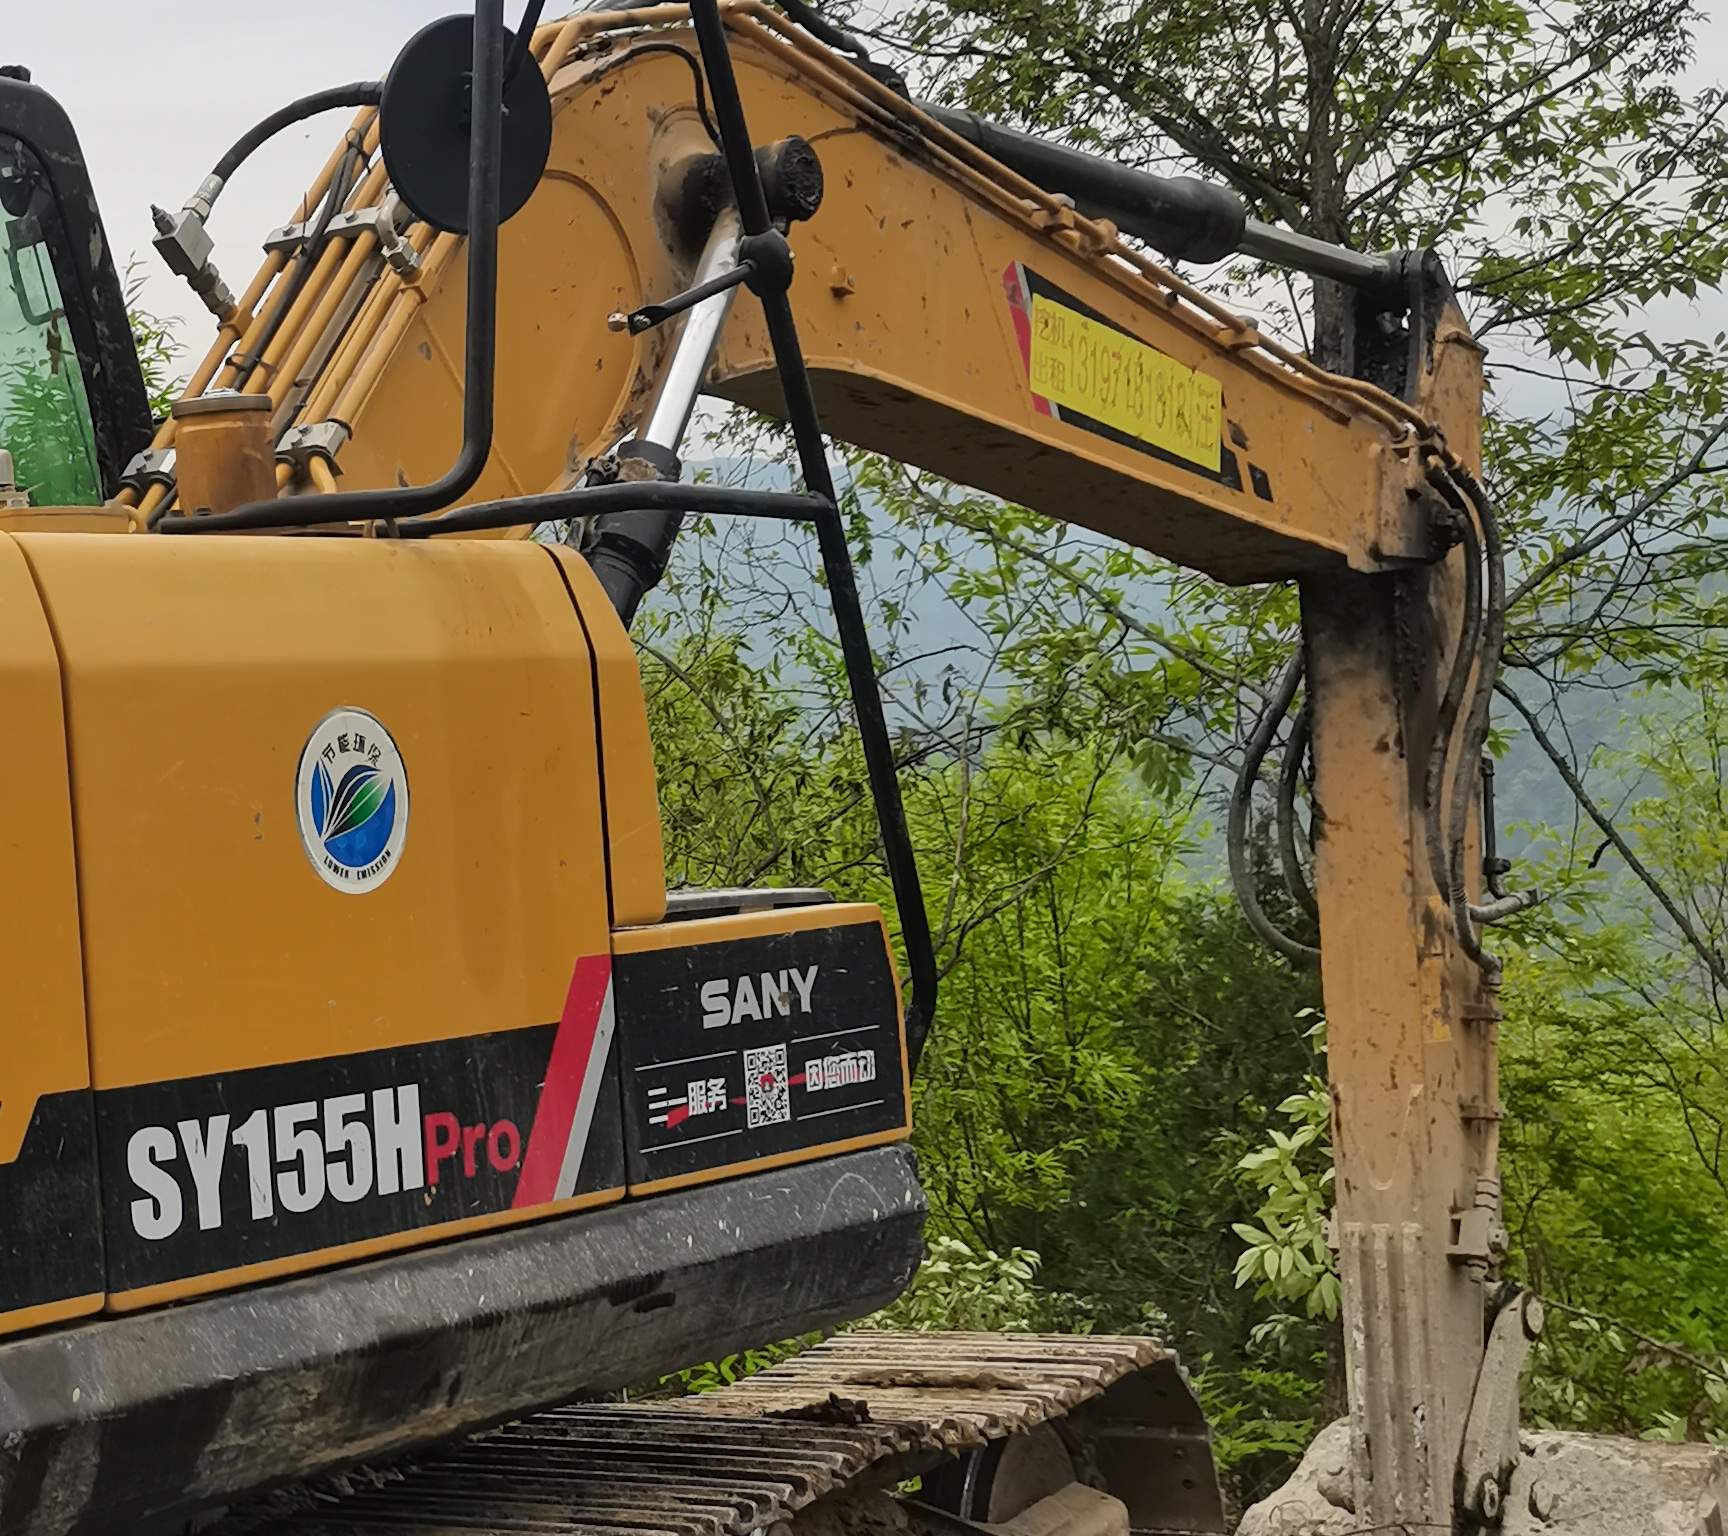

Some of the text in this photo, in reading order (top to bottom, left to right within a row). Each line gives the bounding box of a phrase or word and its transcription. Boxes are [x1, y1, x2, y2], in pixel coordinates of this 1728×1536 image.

[322, 732, 382, 767] 节能环保
[323, 848, 392, 881] LOWER EMISSION
[700, 964, 819, 1030] SANY
